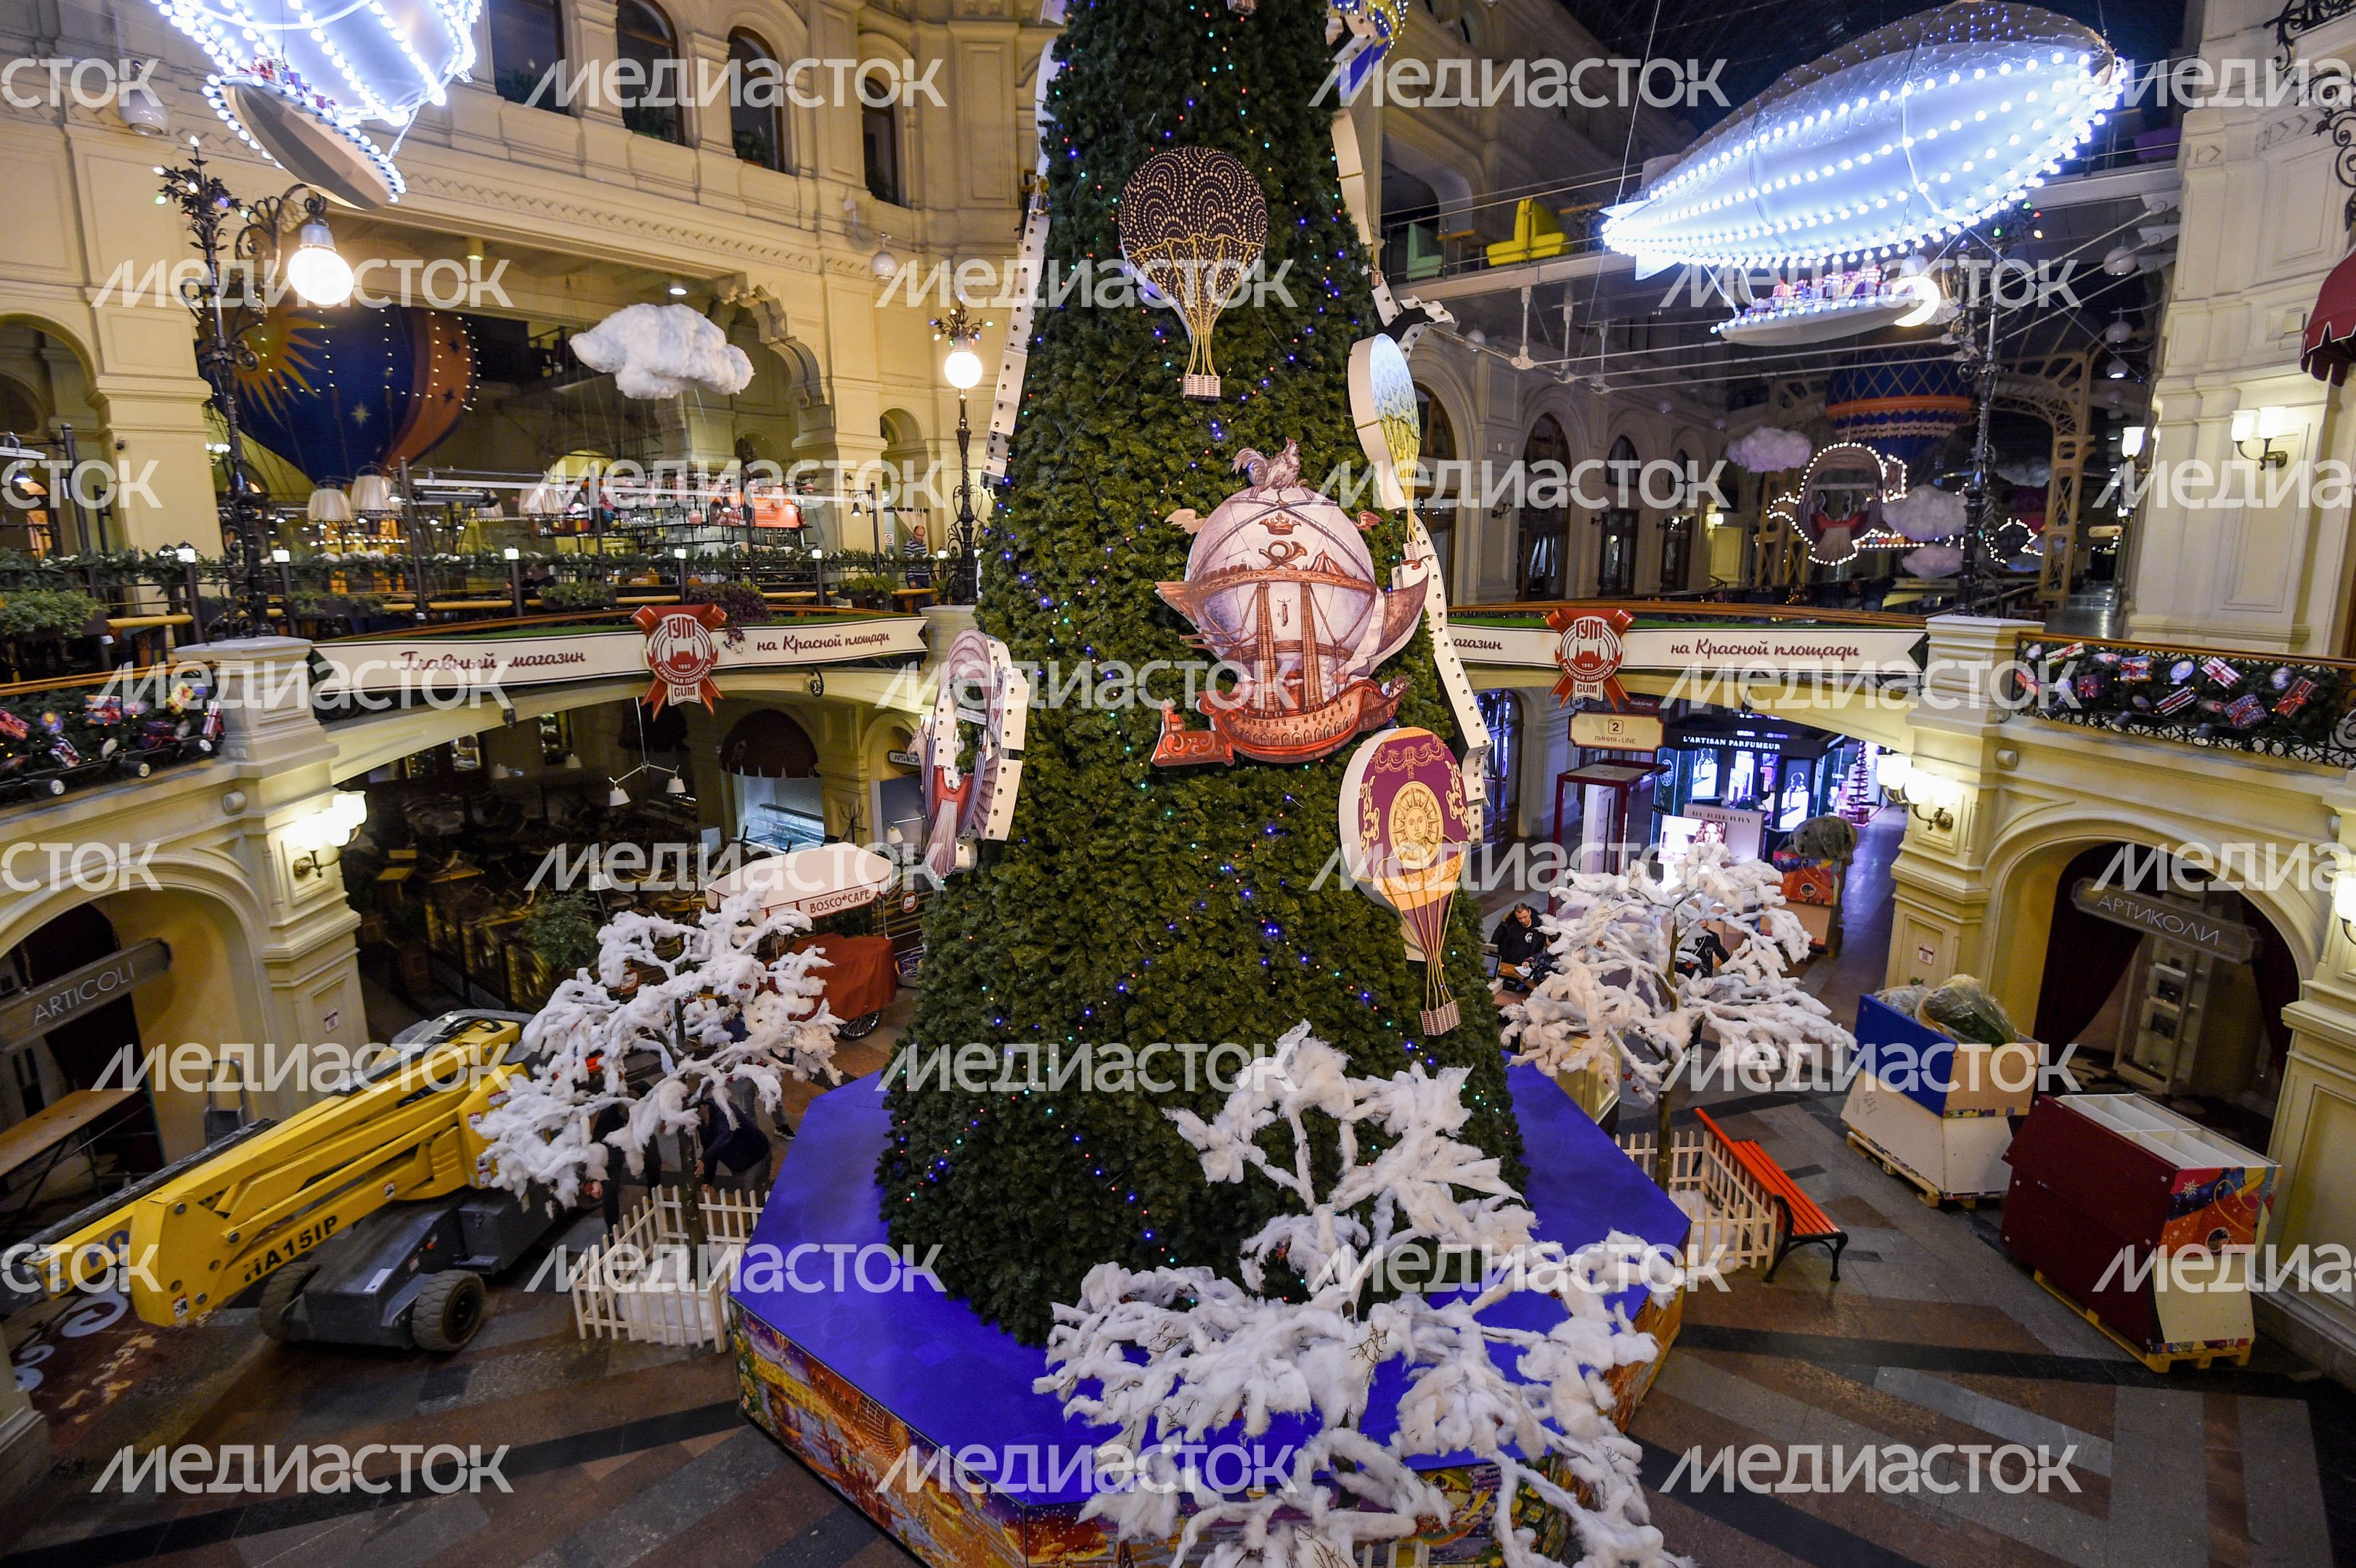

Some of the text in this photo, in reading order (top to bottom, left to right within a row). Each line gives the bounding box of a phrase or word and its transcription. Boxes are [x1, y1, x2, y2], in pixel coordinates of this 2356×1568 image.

[667, 616, 696, 639] ГУМ
[1576, 619, 1603, 640] ГУМ
[757, 632, 890, 654] на Красной площади
[1451, 637, 1503, 650] агазин
[1671, 638, 1860, 661] на Красной площади
[400, 650, 587, 670] Главный магазин
[657, 663, 712, 684] КРАСНАЯ ПЛОЩАДЬ
[1562, 662, 1614, 682] КРАСНАЯ ПЛОЩАДЬ
[674, 685, 696, 697] GUM
[1576, 683, 1597, 693] GUM
[1612, 722, 1619, 732] 2
[1683, 735, 1781, 751] L'ARTISAN PARFUMEUR
[810, 889, 871, 913] BOSCO CAFE
[2097, 895, 2220, 947] АРТИКОЛИ
[33, 962, 136, 1026] ARTICOLI
